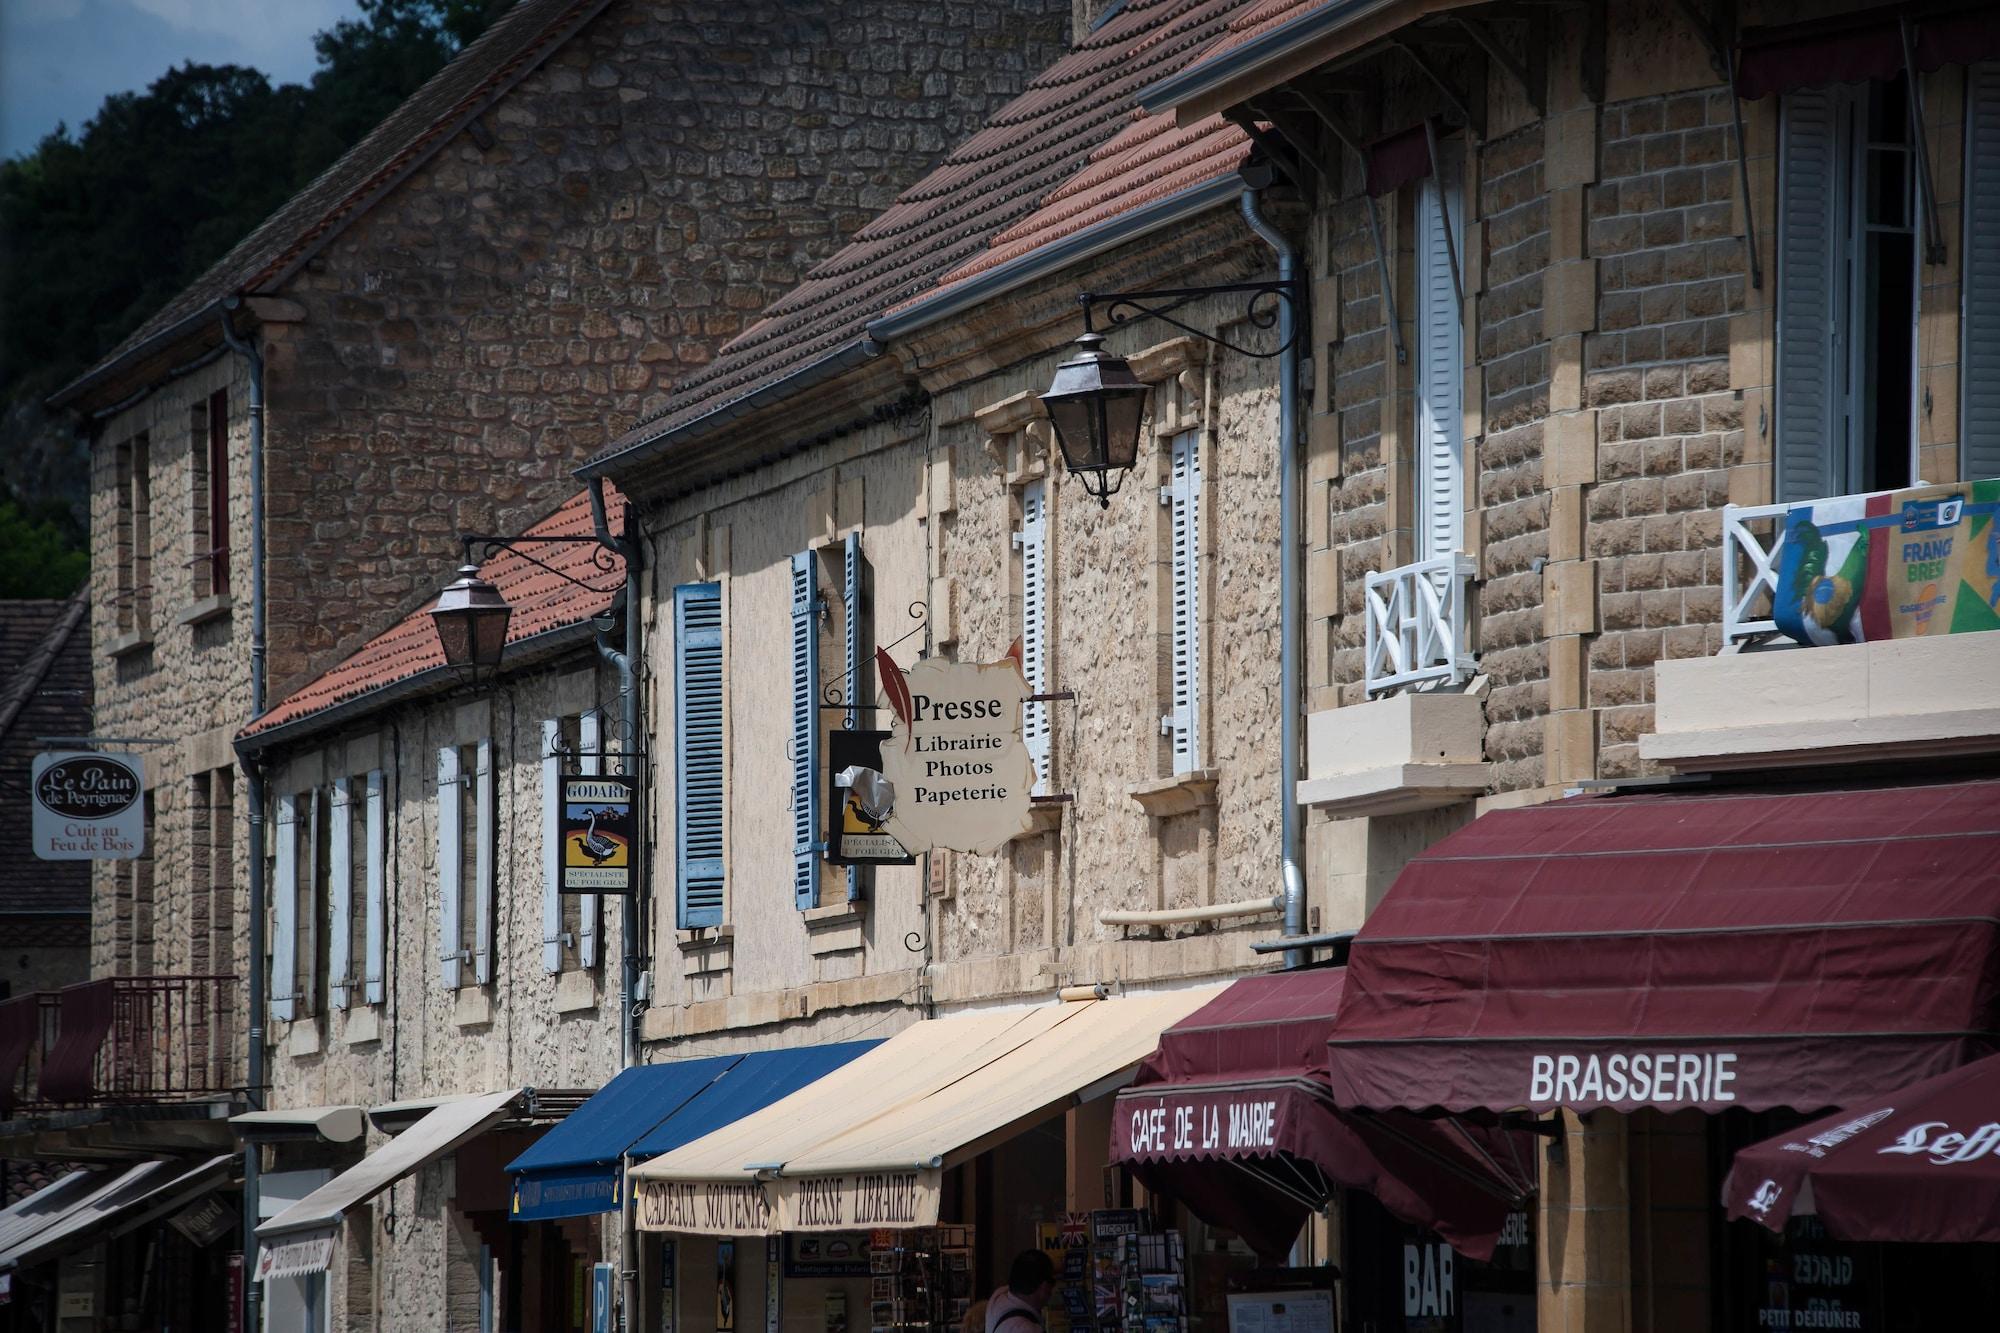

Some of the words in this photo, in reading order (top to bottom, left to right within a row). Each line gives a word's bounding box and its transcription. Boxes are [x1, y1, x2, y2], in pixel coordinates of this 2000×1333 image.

[912, 695, 1002, 721] Presse
[914, 733, 1002, 752] Librairie
[42, 767, 75, 791] Le
[79, 767, 132, 791] Pain
[926, 760, 993, 777] Photos
[46, 791, 64, 805] de
[67, 791, 130, 807] Peyrignac
[914, 784, 1008, 805] Papeterie
[64, 823, 97, 838] Cuit
[101, 826, 119, 837] au
[50, 838, 77, 851] Feu
[81, 838, 98, 851] de
[103, 838, 134, 851] Bois
[1530, 1053, 1738, 1102] BRASSERIE
[1131, 1097, 1166, 1153] CAFÉ
[1174, 1105, 1194, 1149] DE
[1202, 1105, 1219, 1149] LA
[1228, 1101, 1276, 1147] MAIRIE
[1877, 1122, 2000, 1165] Leff
[645, 1183, 697, 1228] CADEAUX
[798, 1178, 843, 1226] PRESSE
[854, 1173, 918, 1224] LIBRAIRIE
[1403, 1243, 1455, 1317] BAR
[1759, 1309, 1791, 1327] PETIT
[1794, 1310, 1862, 1329] DEJEUNER
